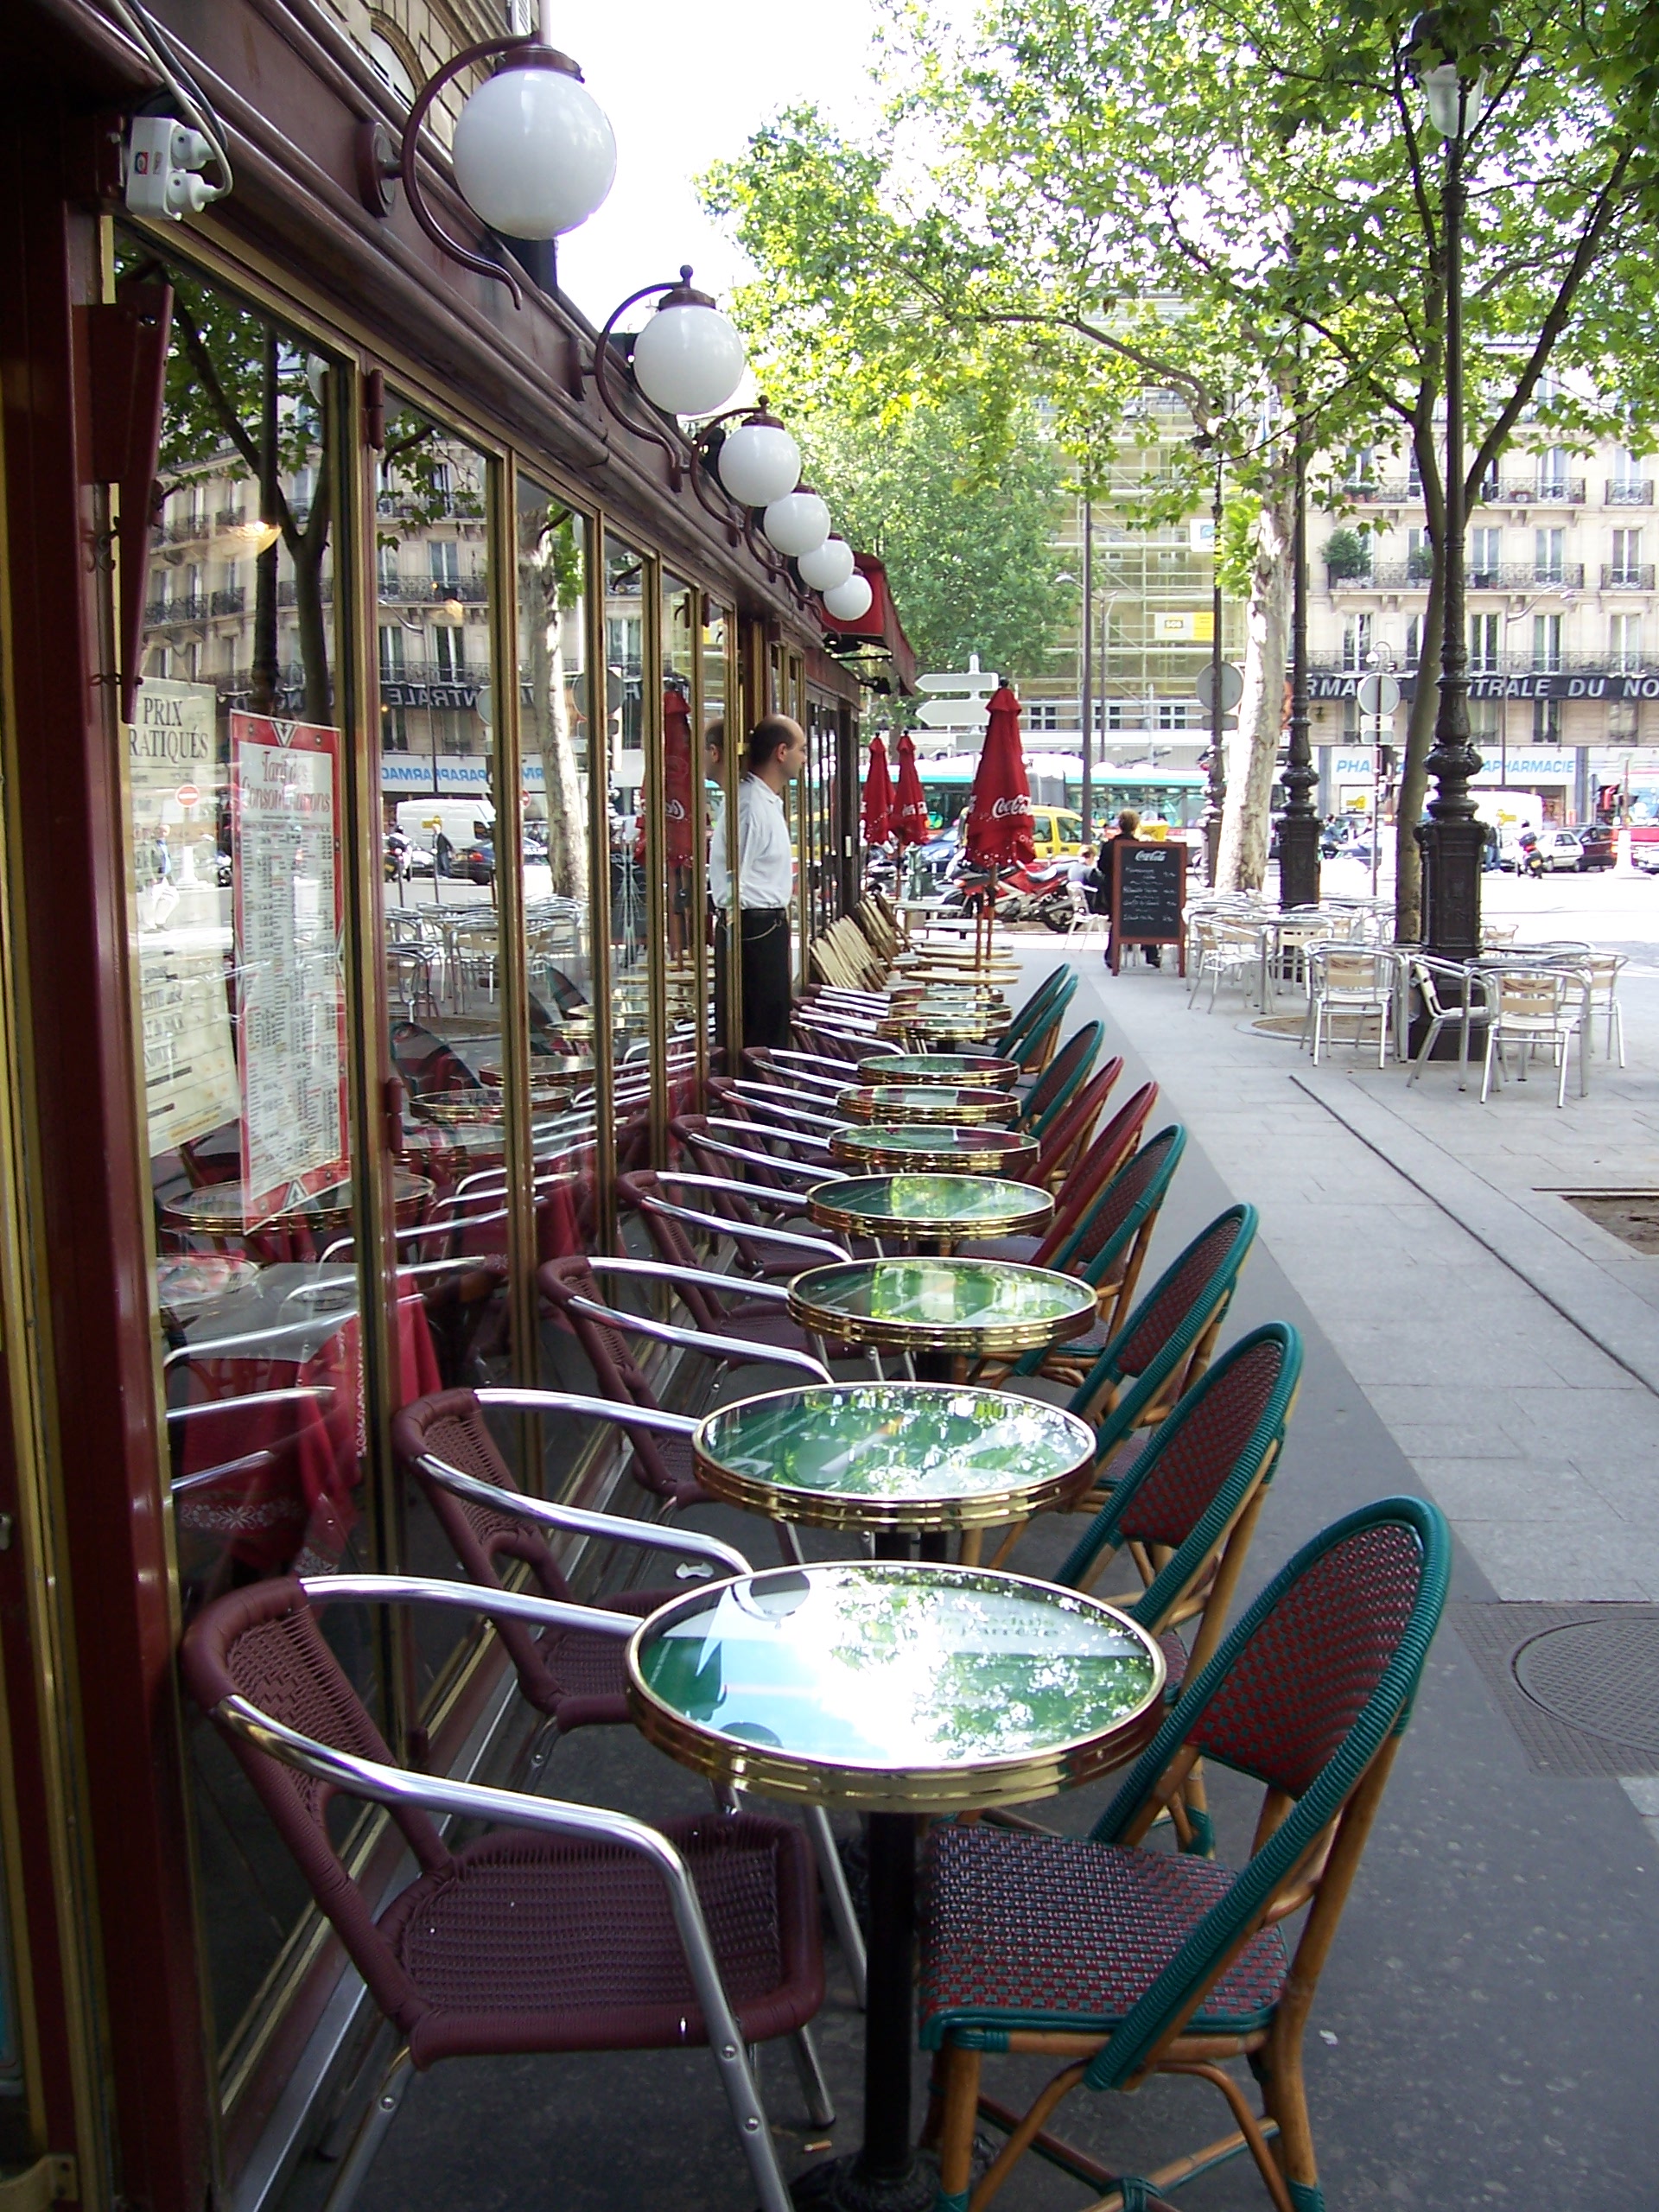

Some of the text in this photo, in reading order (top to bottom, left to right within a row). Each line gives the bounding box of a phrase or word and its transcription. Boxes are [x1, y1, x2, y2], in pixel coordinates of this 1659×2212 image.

[1567, 678, 1605, 696] DU
[1623, 679, 1659, 697] NO
[143, 697, 183, 727] PRIX
[129, 724, 209, 764] RATIQUÉS
[1482, 760, 1575, 773] APHARMACIE
